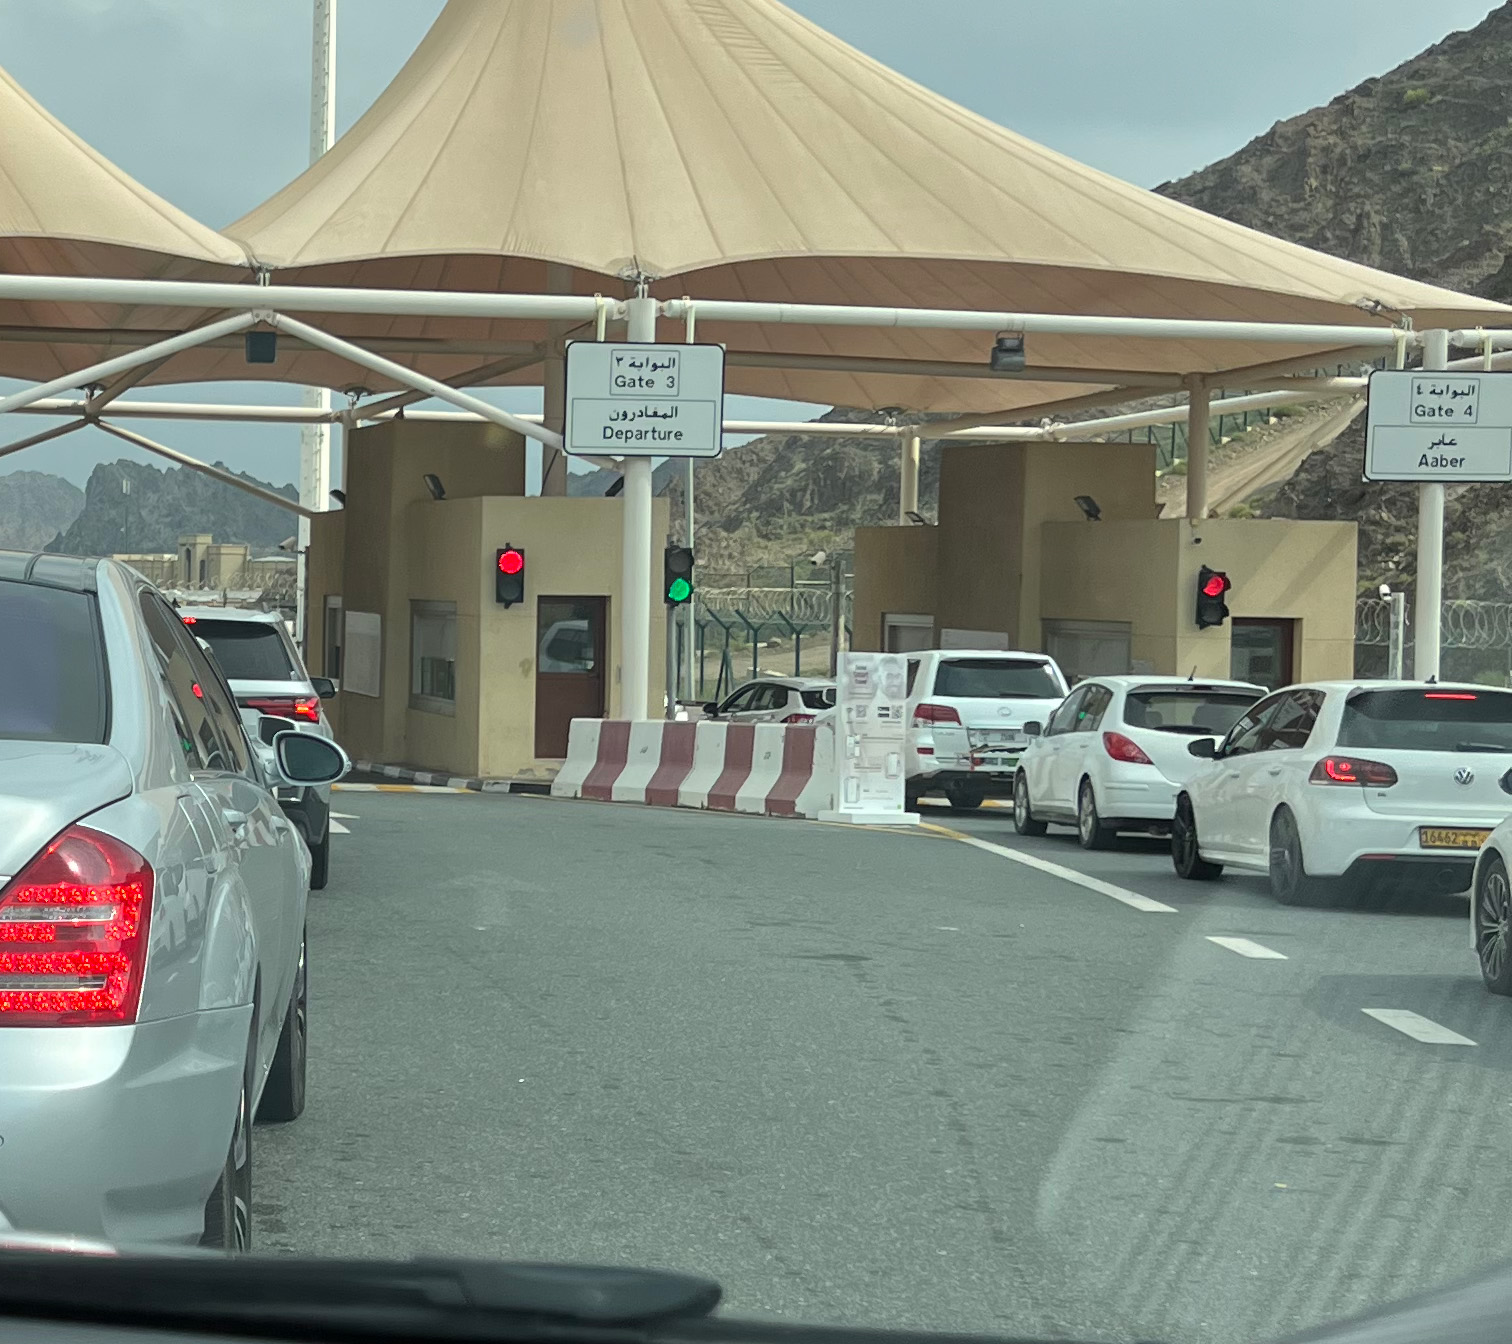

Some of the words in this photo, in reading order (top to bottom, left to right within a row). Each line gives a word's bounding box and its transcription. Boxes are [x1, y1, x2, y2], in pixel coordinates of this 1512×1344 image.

[628, 356, 676, 372] البوابة
[614, 374, 655, 389] Gate
[666, 375, 675, 389] 3
[1429, 383, 1476, 400] البوابة
[608, 405, 678, 422] المغادرون
[1414, 403, 1454, 417] Gate
[1463, 404, 1473, 417] 4
[602, 425, 683, 444] Departure
[1427, 432, 1458, 451] عابر
[1418, 452, 1466, 469] Aaber
